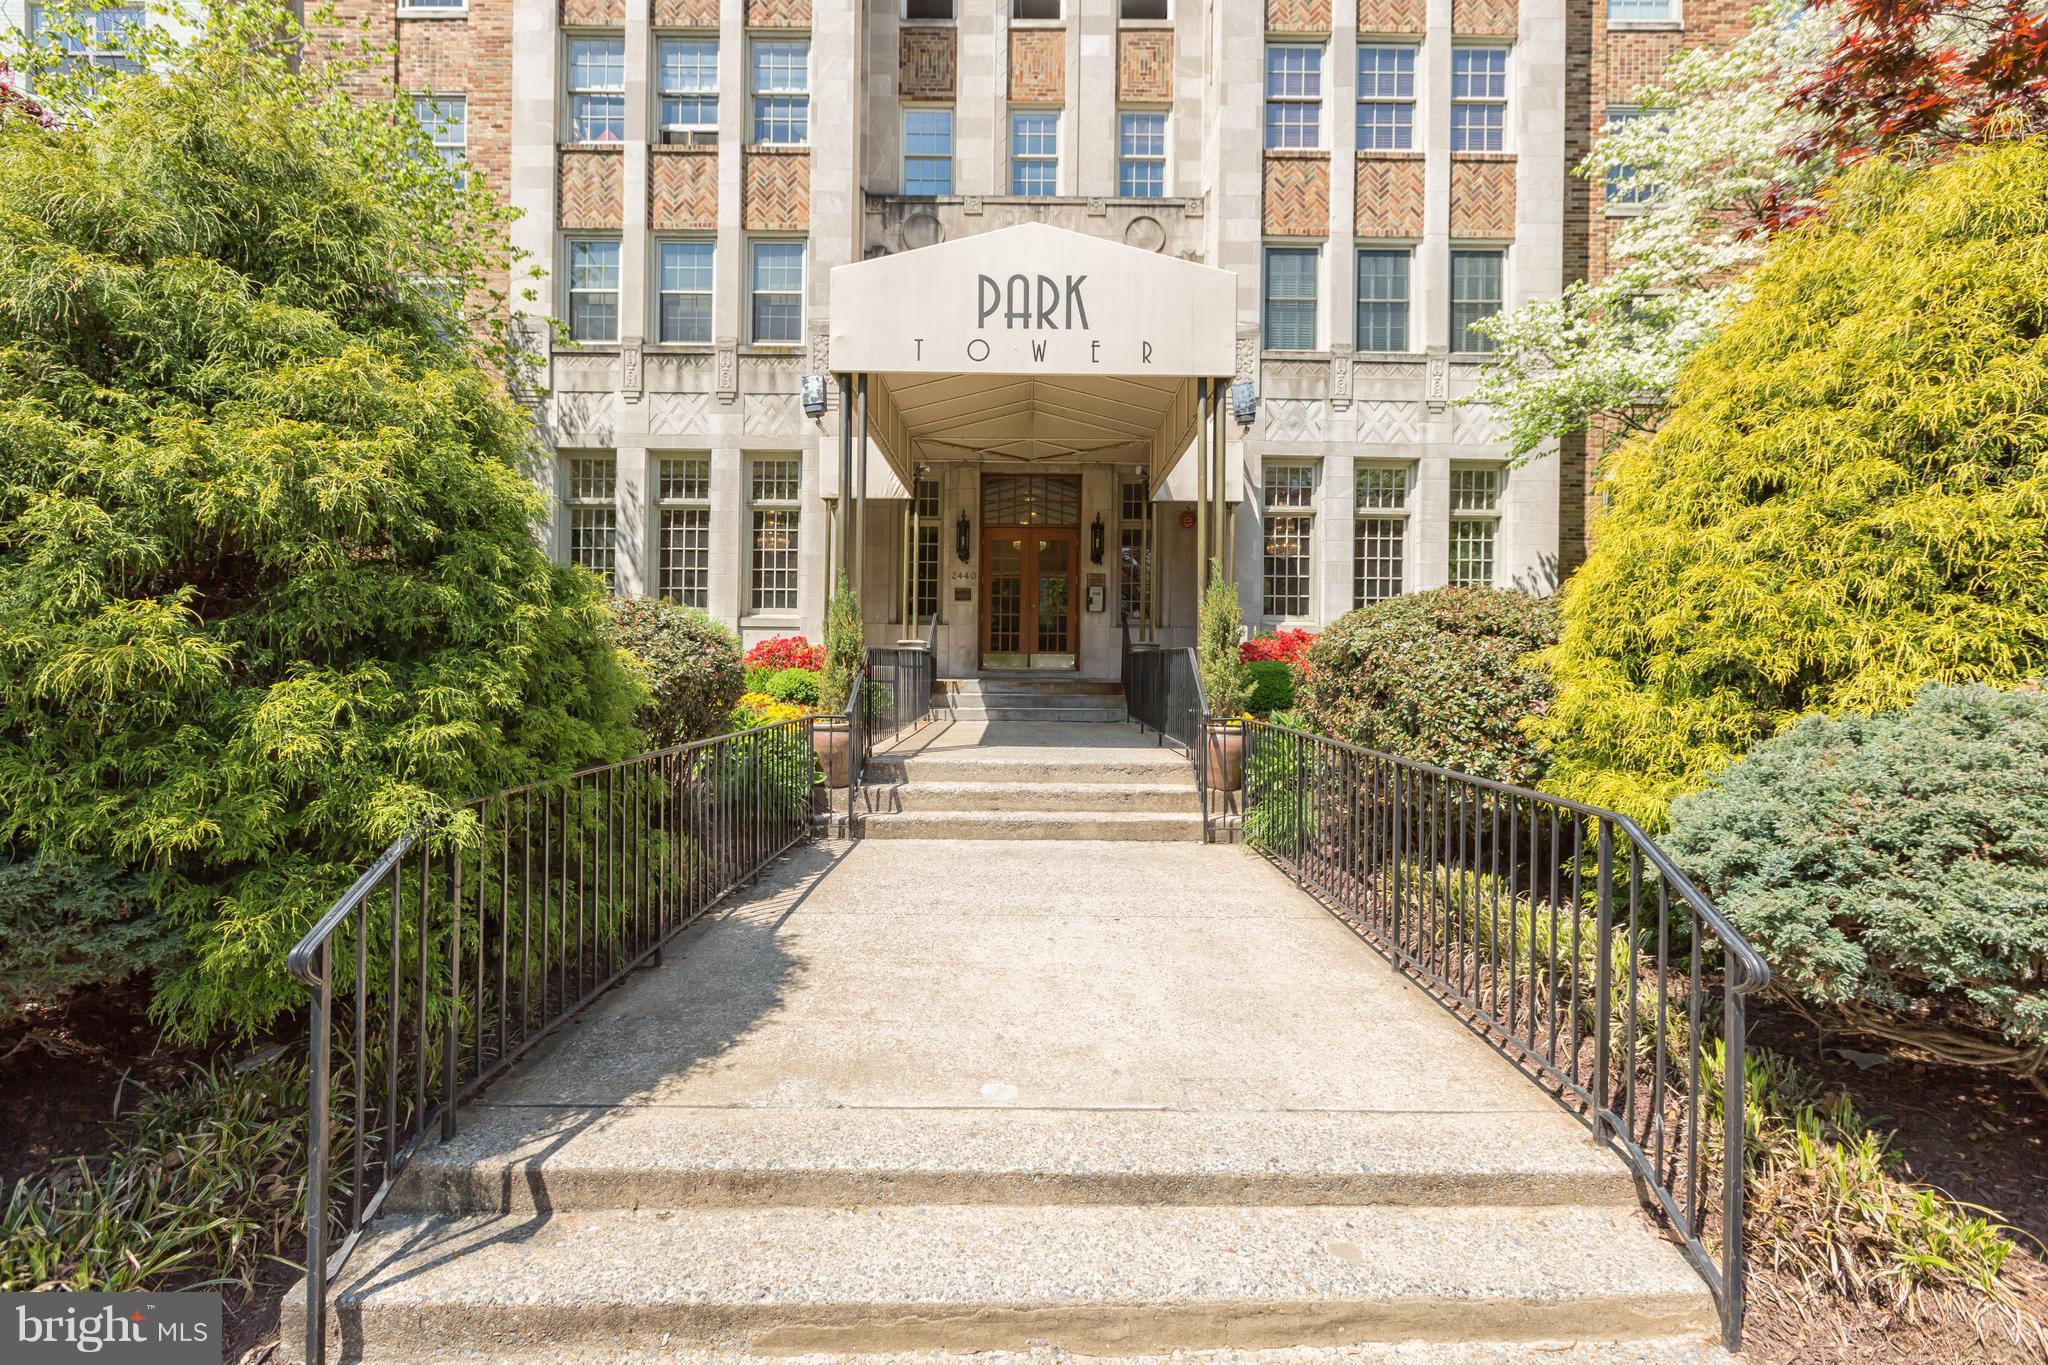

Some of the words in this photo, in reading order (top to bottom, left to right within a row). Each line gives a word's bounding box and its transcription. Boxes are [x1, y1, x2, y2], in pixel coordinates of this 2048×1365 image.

[977, 274, 1090, 330] PARK
[914, 338, 1153, 364] TOWER
[951, 571, 977, 580] 2440
